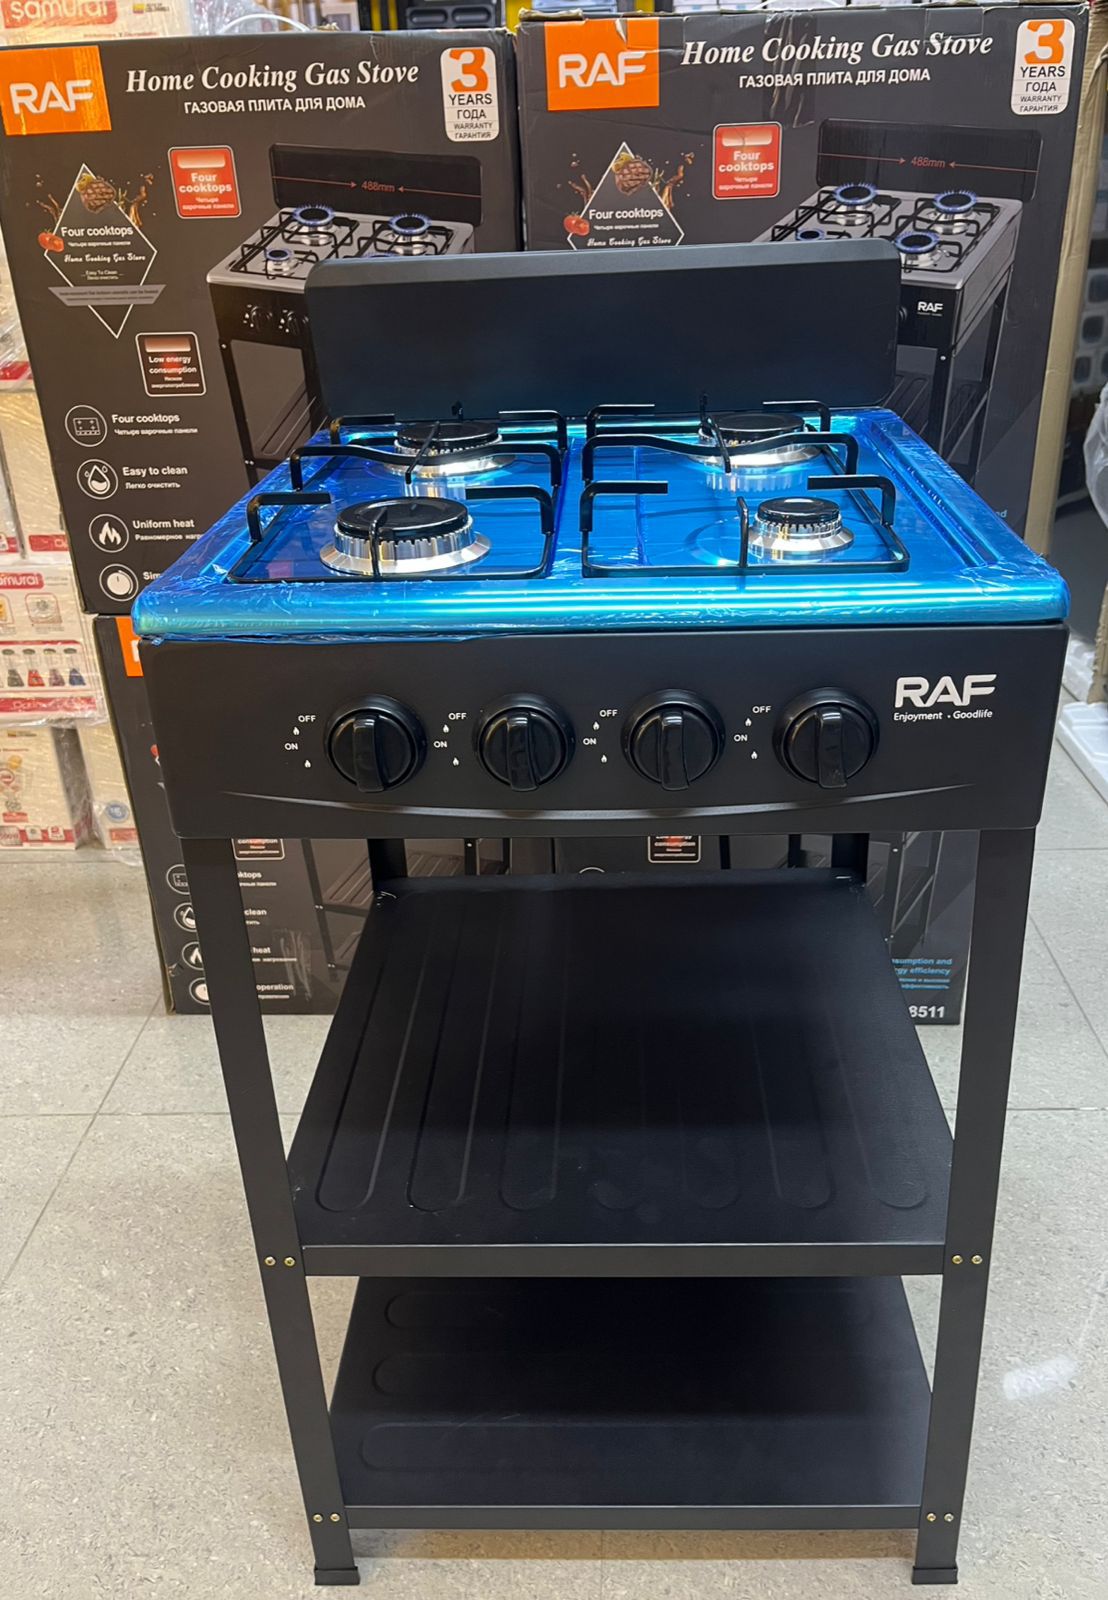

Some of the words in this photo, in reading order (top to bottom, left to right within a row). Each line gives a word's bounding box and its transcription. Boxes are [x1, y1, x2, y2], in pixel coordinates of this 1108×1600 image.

[1024, 20, 1066, 65] 3
[680, 41, 754, 66] Home
[761, 37, 864, 64] Cooking
[871, 34, 919, 58] Gas
[925, 32, 993, 56] Stove
[449, 48, 489, 92] 3
[558, 51, 647, 89] RAF
[1020, 66, 1066, 79] YEARS
[125, 69, 194, 93] Home
[201, 64, 297, 93] Cooking
[304, 62, 350, 86] Gas
[356, 60, 419, 84] Stove
[739, 73, 803, 89] ГАЗОВАЯ
[806, 71, 853, 86] ПЛИТА
[855, 69, 886, 86] ДЛЯ
[888, 69, 931, 84] ДОМА
[1025, 82, 1057, 93] ГОДА
[9, 79, 94, 115] RAF
[449, 93, 493, 106] YEARS
[1020, 95, 1062, 103] WARRANTY
[184, 99, 246, 115] ГАЗОВАЯ
[248, 97, 293, 113] ПЛИТА
[295, 97, 323, 112] ДЛЯ
[326, 96, 366, 111] ДОМА
[1019, 104, 1059, 113] ГАРАНТИЯ
[457, 107, 487, 120] ГОДА
[453, 122, 493, 130] WARRANTY
[454, 131, 492, 140] ГАРАНТИЯ
[733, 151, 761, 161] Four
[718, 161, 775, 173] cooktops
[190, 172, 217, 183] Four
[179, 181, 233, 195] cooktops
[361, 180, 396, 193] 488mm
[589, 209, 613, 220] Four
[615, 208, 664, 221] cooktops
[61, 227, 85, 238] Four
[86, 225, 134, 238] cooktops
[918, 301, 943, 312] RAF
[148, 356, 164, 364] Low
[166, 356, 191, 365] energy
[149, 367, 197, 375] consumption
[111, 414, 134, 423] Four
[136, 413, 180, 424] cooktops
[122, 466, 147, 477] Easy
[149, 466, 160, 475] to
[162, 465, 188, 475] clean
[132, 520, 172, 529] Uniform
[173, 519, 195, 529] heat
[142, 571, 162, 580] Sim
[894, 674, 997, 708] RAF
[599, 709, 618, 717] OFF
[752, 705, 771, 714] OFF
[298, 714, 316, 723] OFF
[448, 712, 467, 720] OFF
[893, 712, 942, 722] Enjoyment
[952, 709, 993, 719] Goodlife
[582, 737, 597, 746] ON
[733, 734, 748, 742] ON
[284, 742, 299, 751] ON
[433, 740, 448, 748] ON
[238, 871, 262, 879] ktops
[252, 946, 271, 954] heat
[892, 958, 934, 966] sumption
[910, 967, 951, 976] efficiency
[256, 984, 294, 992] operation
[909, 1005, 945, 1018] 8511
